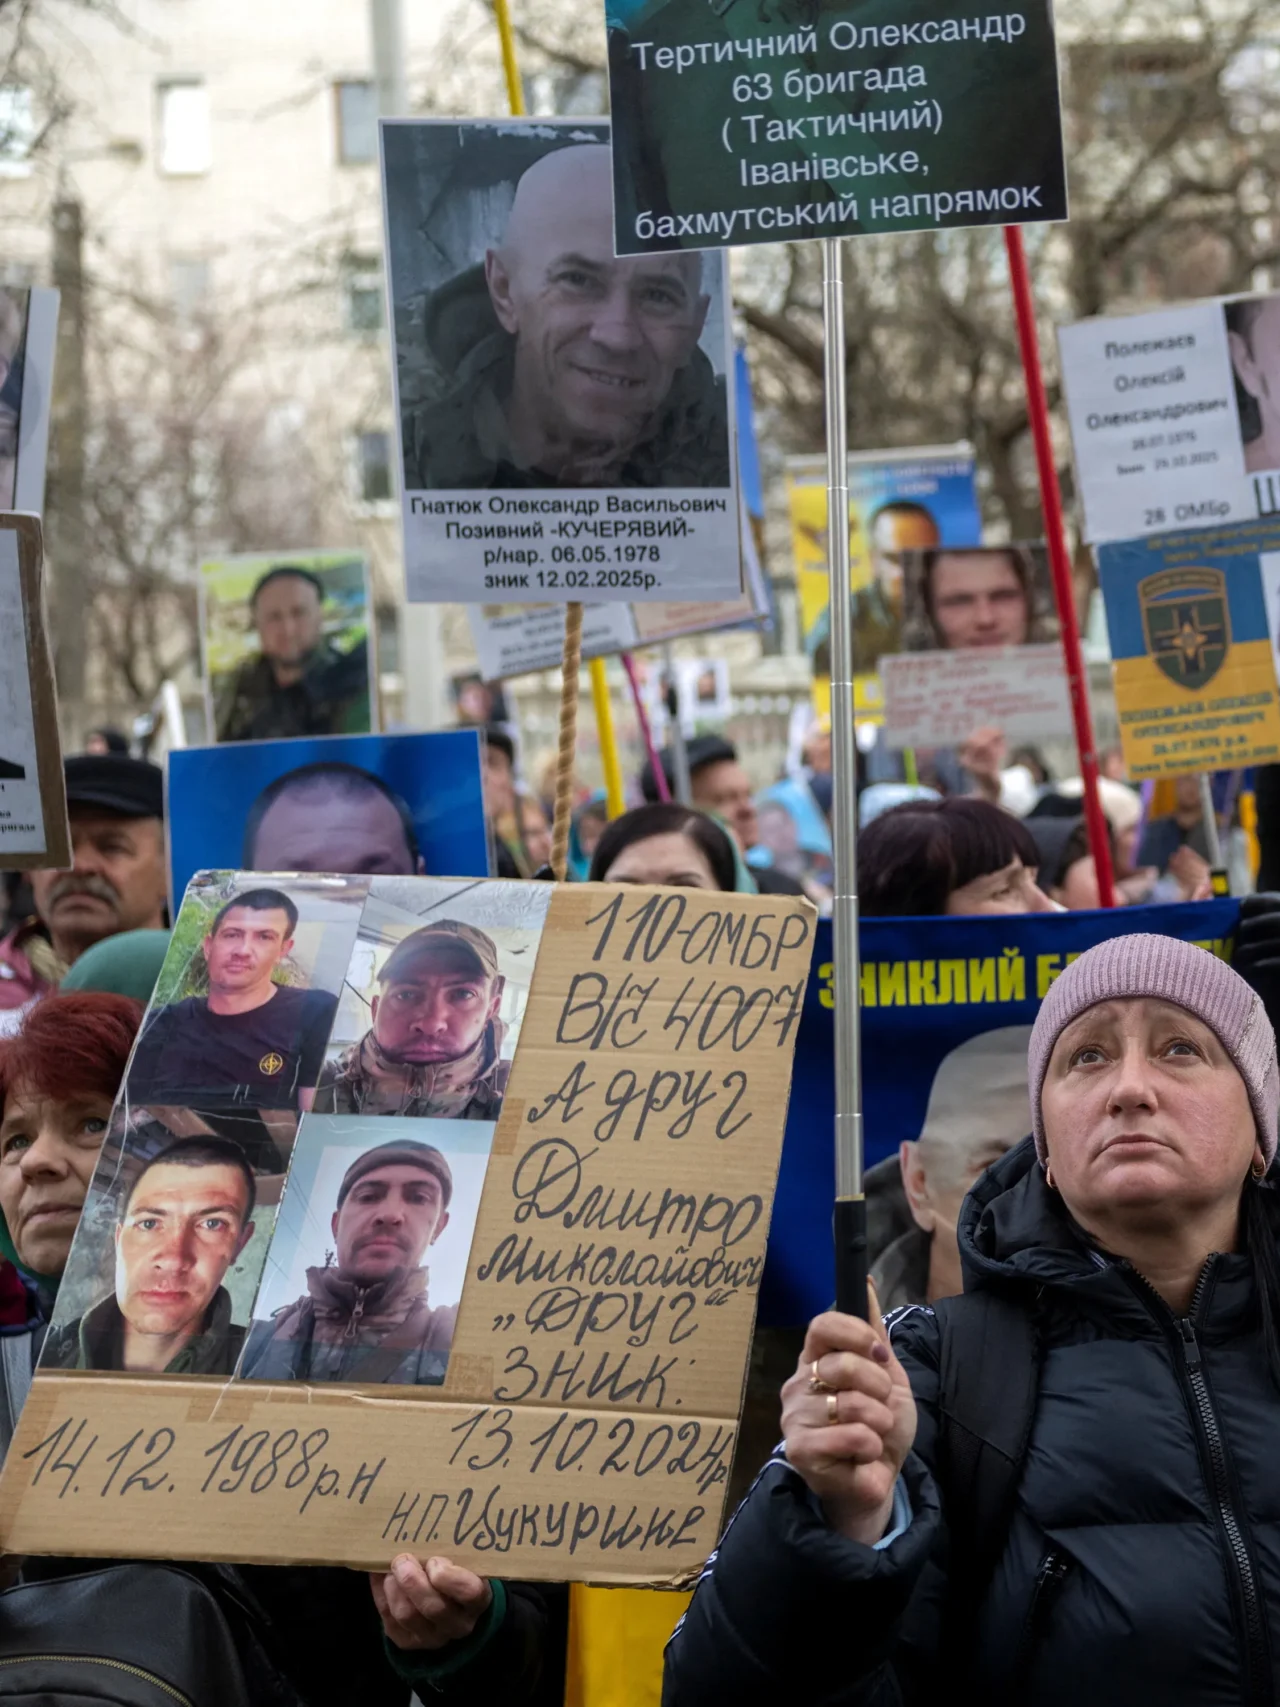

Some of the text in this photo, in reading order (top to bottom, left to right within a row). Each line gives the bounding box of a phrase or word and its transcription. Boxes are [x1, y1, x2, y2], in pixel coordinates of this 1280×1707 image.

[632, 13, 1026, 73] Тертичний Олександр
[732, 64, 928, 102] 63 бригада
[741, 149, 930, 187] Іванівське,
[634, 185, 1042, 240] бахмутський напрямок
[1114, 365, 1186, 393] Олексій
[1086, 397, 1228, 431] Олександрович
[411, 496, 726, 516] Гнатюк Олександр Васильович
[1144, 507, 1166, 526] 28
[446, 521, 543, 539] Позивний
[484, 546, 660, 567] р/нар. 06.05.1978
[485, 571, 662, 591] зник 12.02.2025р.
[817, 947, 1024, 1009] ЗНИКЛИЙ
[512, 1138, 763, 1247] Дмитро
[477, 1233, 762, 1288] Миколайович
